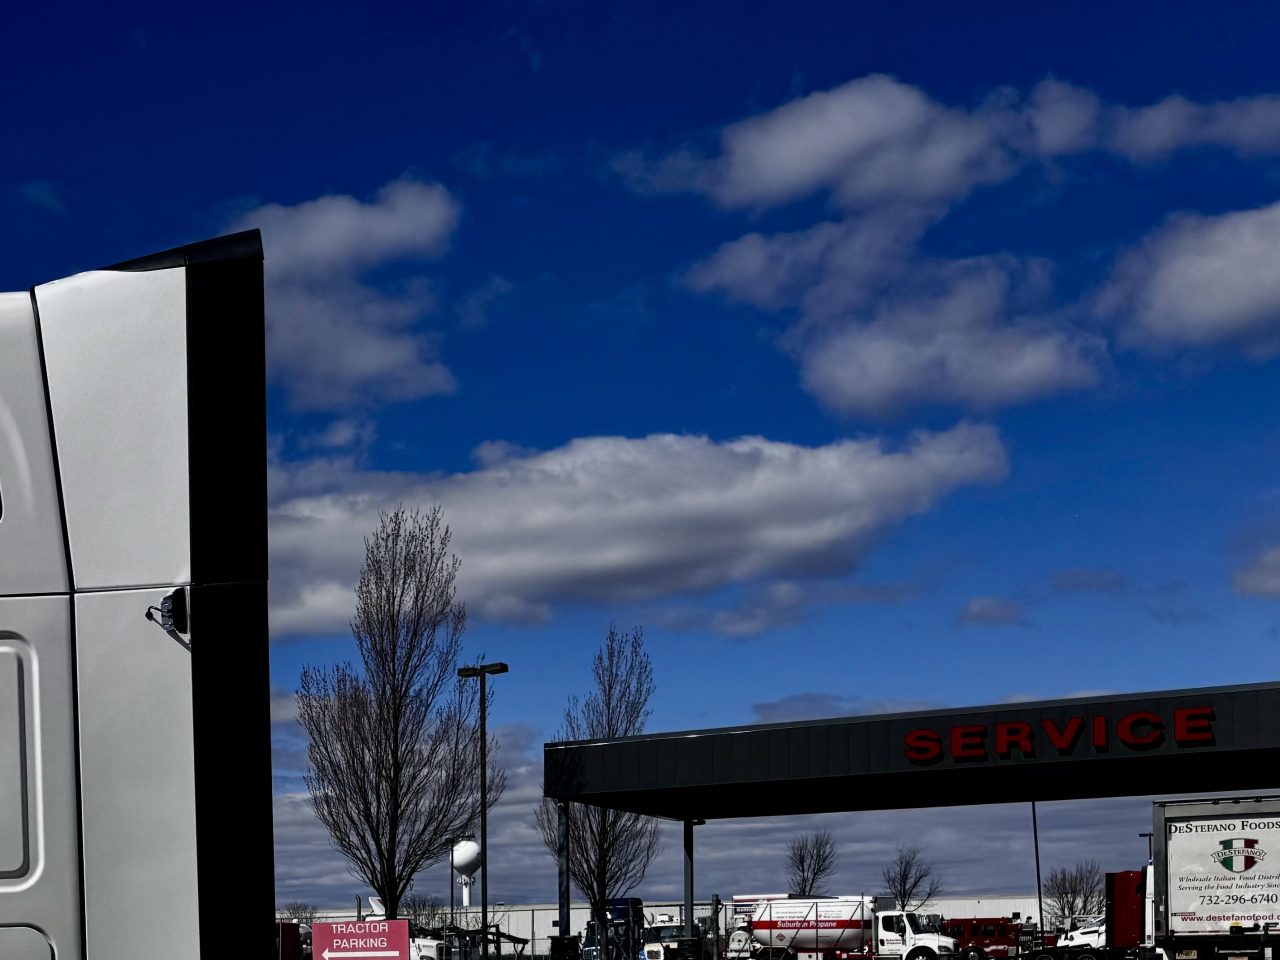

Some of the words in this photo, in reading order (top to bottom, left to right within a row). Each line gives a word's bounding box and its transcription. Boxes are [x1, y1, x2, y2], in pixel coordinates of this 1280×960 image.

[903, 706, 1216, 764] SERVICE
[1199, 893, 1278, 905] 732-296-6740
[331, 922, 389, 934] TRACTOR
[333, 938, 387, 949] PARKING
